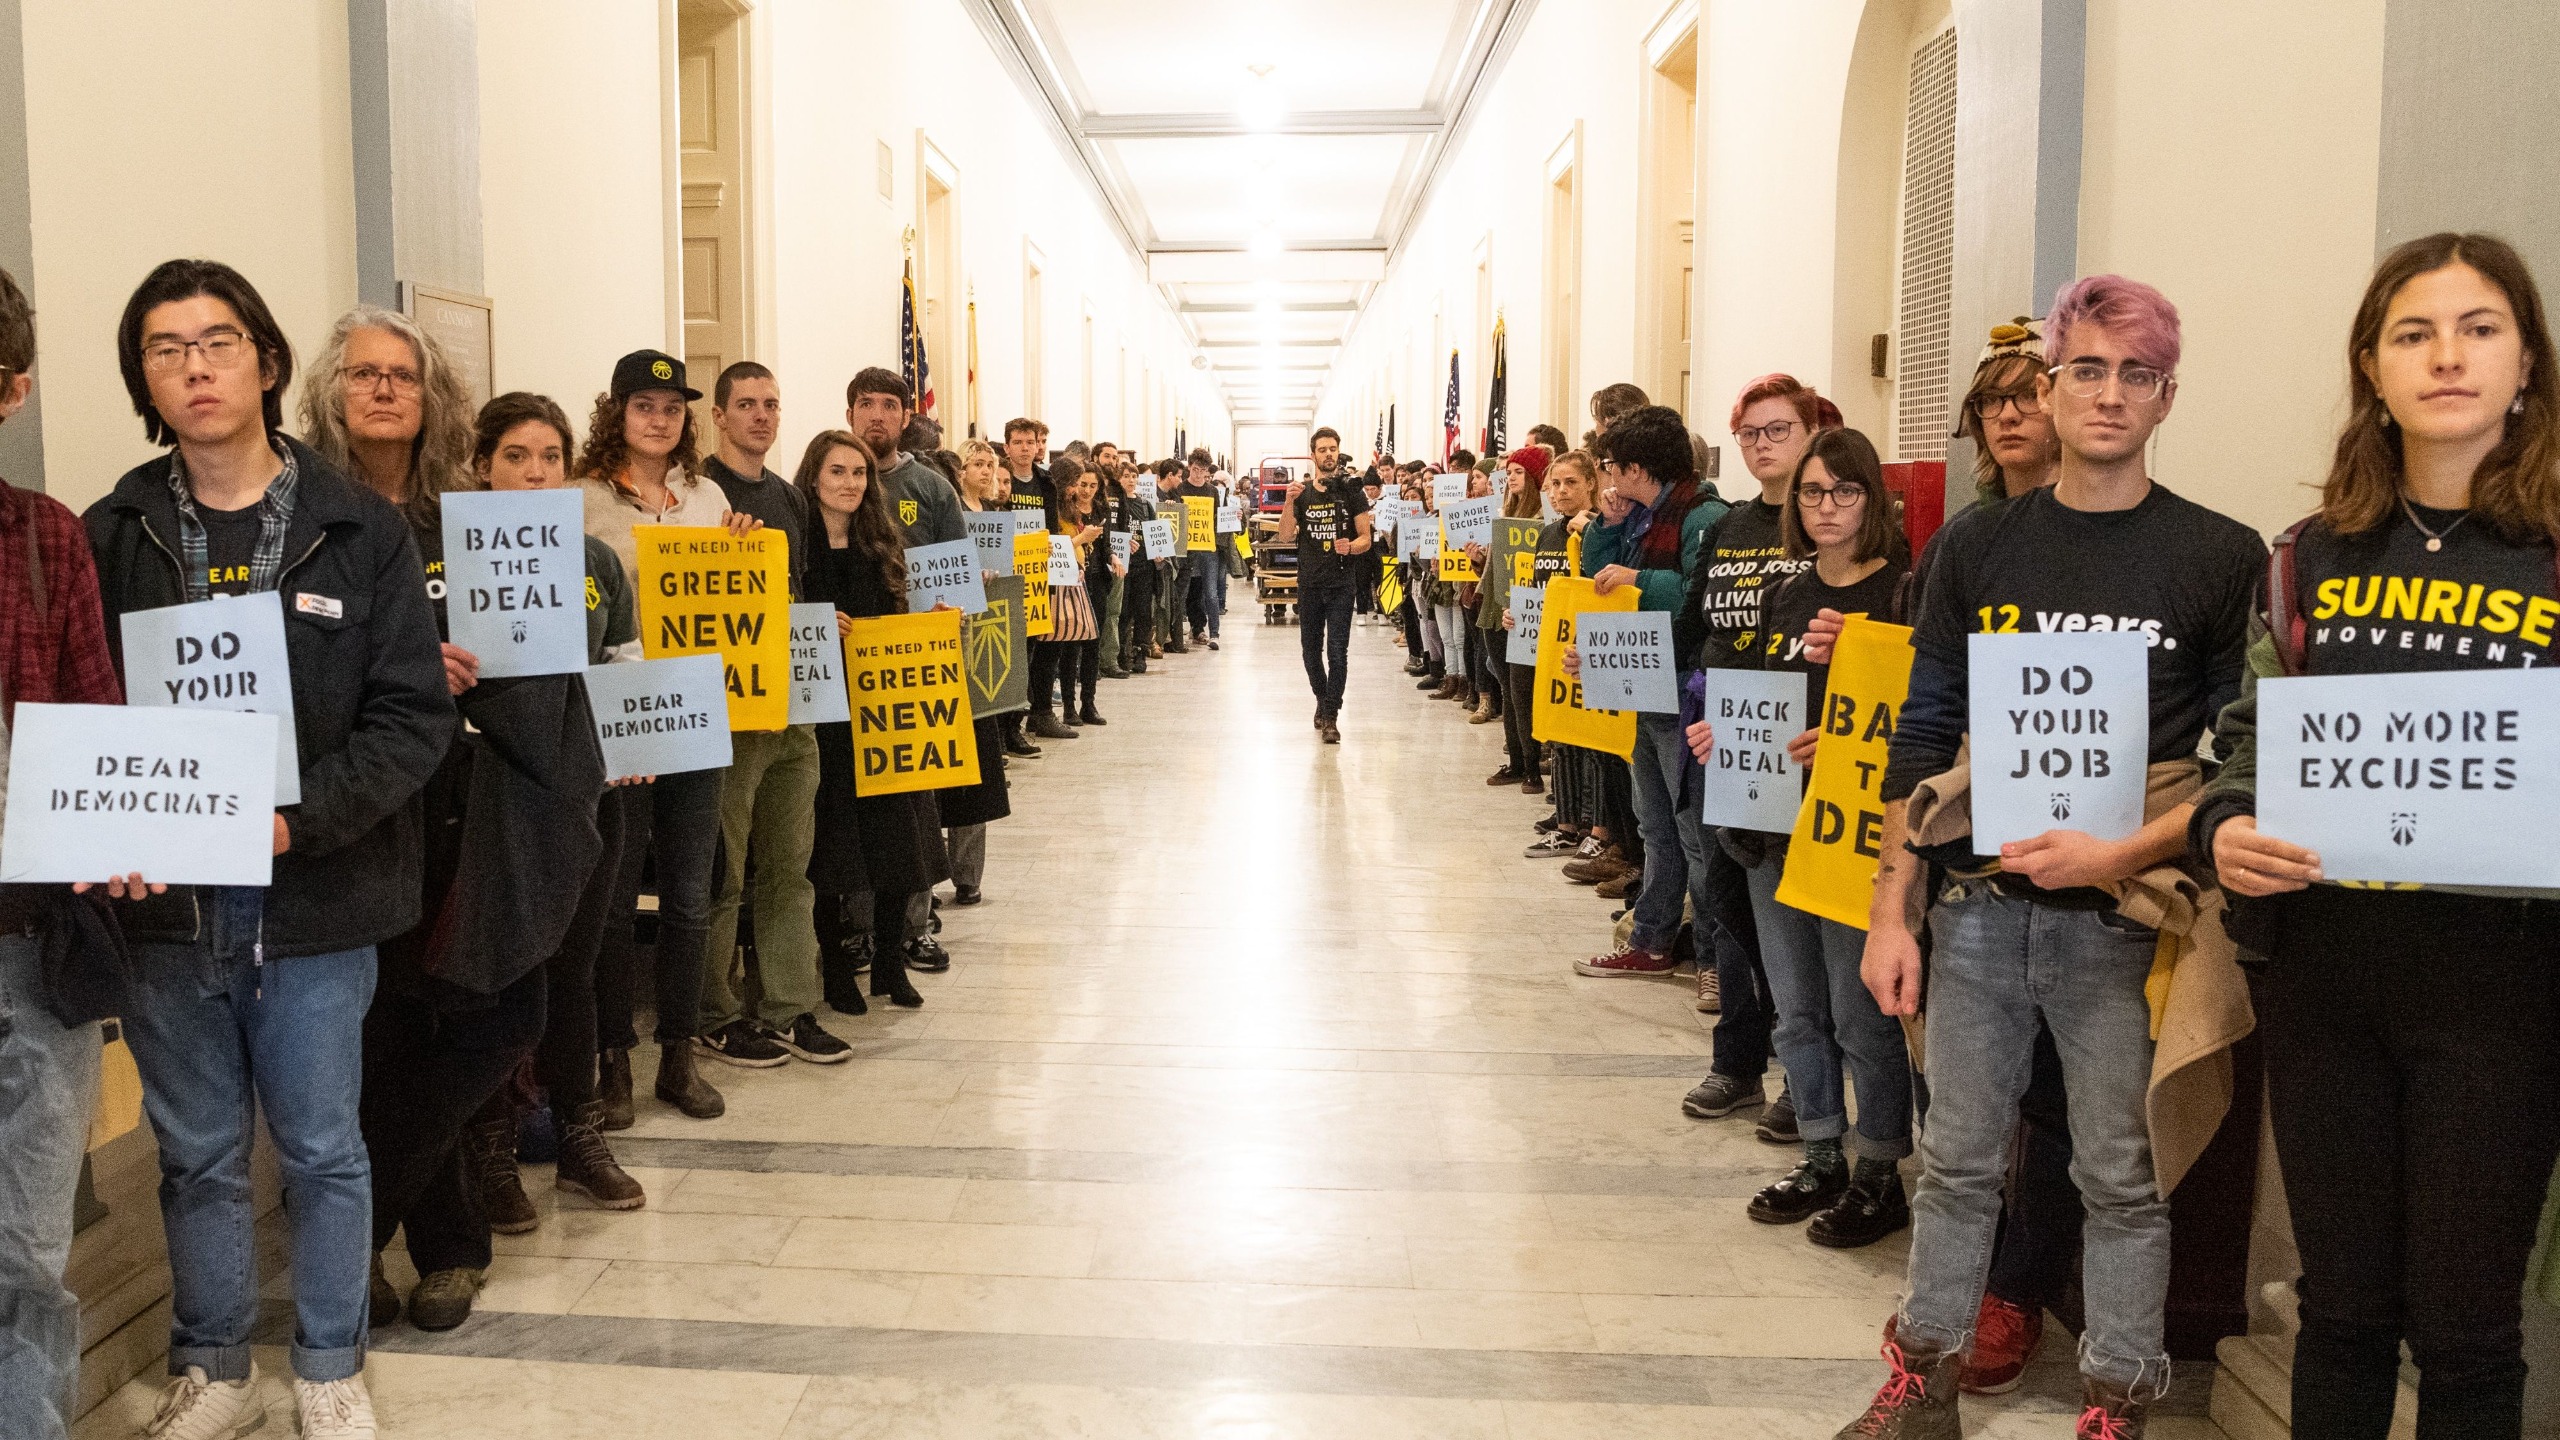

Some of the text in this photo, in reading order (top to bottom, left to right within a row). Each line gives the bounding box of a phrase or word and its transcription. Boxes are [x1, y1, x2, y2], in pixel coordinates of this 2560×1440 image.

[1011, 494, 1043, 505] UNRIS
[1448, 505, 1489, 520] NO MORE
[1450, 516, 1490, 530] EXCUSES
[968, 523, 1003, 534] MORE
[1016, 521, 1041, 529] BACK
[466, 524, 560, 551] BACK
[657, 540, 766, 555] WE NEED THE
[1509, 527, 1539, 548] DO
[927, 554, 968, 571] MORE
[1717, 547, 1784, 558] WE HAVE A RIG
[209, 566, 250, 583] EAR
[491, 558, 541, 576] THE
[1050, 561, 1070, 569] JOB
[1708, 558, 1813, 578] GOOD JOBS
[660, 570, 767, 597] GREEN
[907, 571, 970, 592] EXCUSES
[1024, 580, 1048, 598] EW
[1734, 577, 1762, 588] AND
[470, 584, 563, 613] DEAL
[1704, 589, 1764, 610] A LIVA
[1025, 604, 1048, 621] AL
[1521, 614, 1541, 624] YOU
[1711, 610, 1760, 628] FUTU
[1978, 604, 2021, 634] 12
[2312, 575, 2560, 648] SUNRISE
[661, 613, 765, 649] NEW
[790, 626, 828, 641] ACK
[1520, 628, 1538, 640] JO
[1589, 631, 1609, 647] NO
[1616, 630, 1659, 647] MORE
[176, 631, 241, 665] DO
[790, 648, 818, 658] THE
[856, 639, 957, 658] WE NEED THE
[1766, 633, 1783, 655] 2
[2315, 626, 2537, 669] MOVEMENT
[1589, 653, 1661, 669] EXCUSES
[725, 663, 767, 698] AL
[794, 665, 831, 681] EAL
[858, 663, 959, 692] GREEN
[2021, 665, 2093, 696] DO
[165, 671, 258, 704] YOUR
[623, 693, 683, 714] DEAR
[1720, 697, 1789, 723] BACK
[602, 713, 709, 739] DEMOCRATS
[860, 697, 959, 734] NEW
[1826, 692, 1896, 744] BA
[2008, 709, 2109, 735] YOUR
[1736, 726, 1772, 744] THE
[2301, 710, 2519, 743] NO MORE
[96, 756, 200, 780] DEAR
[864, 739, 964, 777] DEAL
[1719, 748, 1787, 775] DEAL
[2010, 748, 2111, 778] JOB
[2301, 757, 2518, 790] EXCUSES
[50, 788, 240, 816] DEMOCRATS
[1812, 799, 1882, 860] DE
